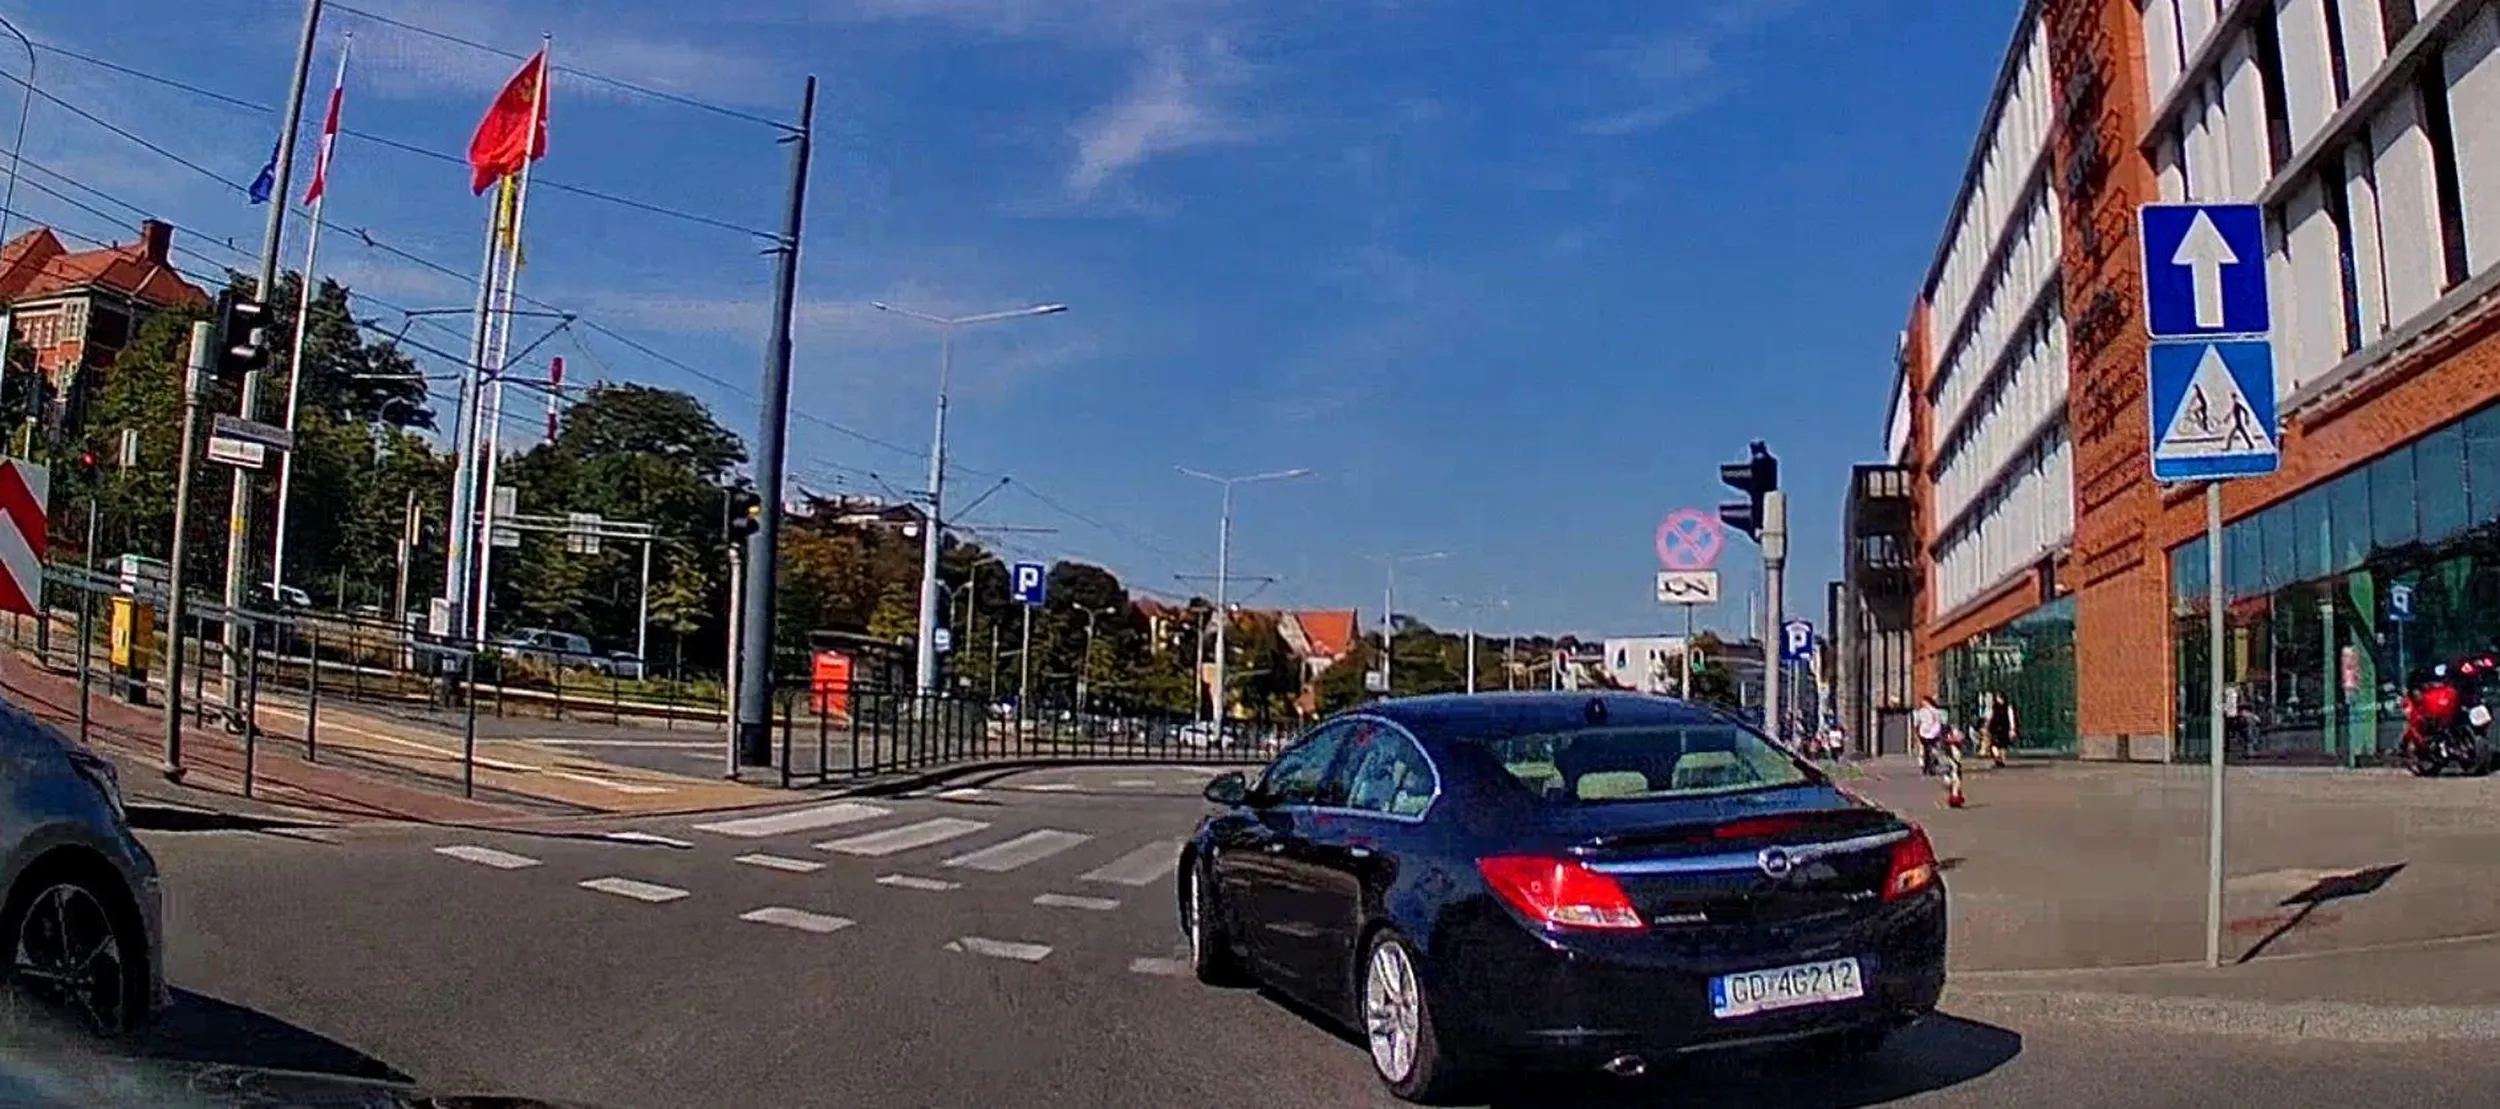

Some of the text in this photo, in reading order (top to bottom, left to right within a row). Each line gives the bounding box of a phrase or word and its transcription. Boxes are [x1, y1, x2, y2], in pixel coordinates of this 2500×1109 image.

[1019, 567, 1038, 593] P
[1789, 630, 1806, 655] P
[1732, 961, 1853, 1003] GD 4G212
